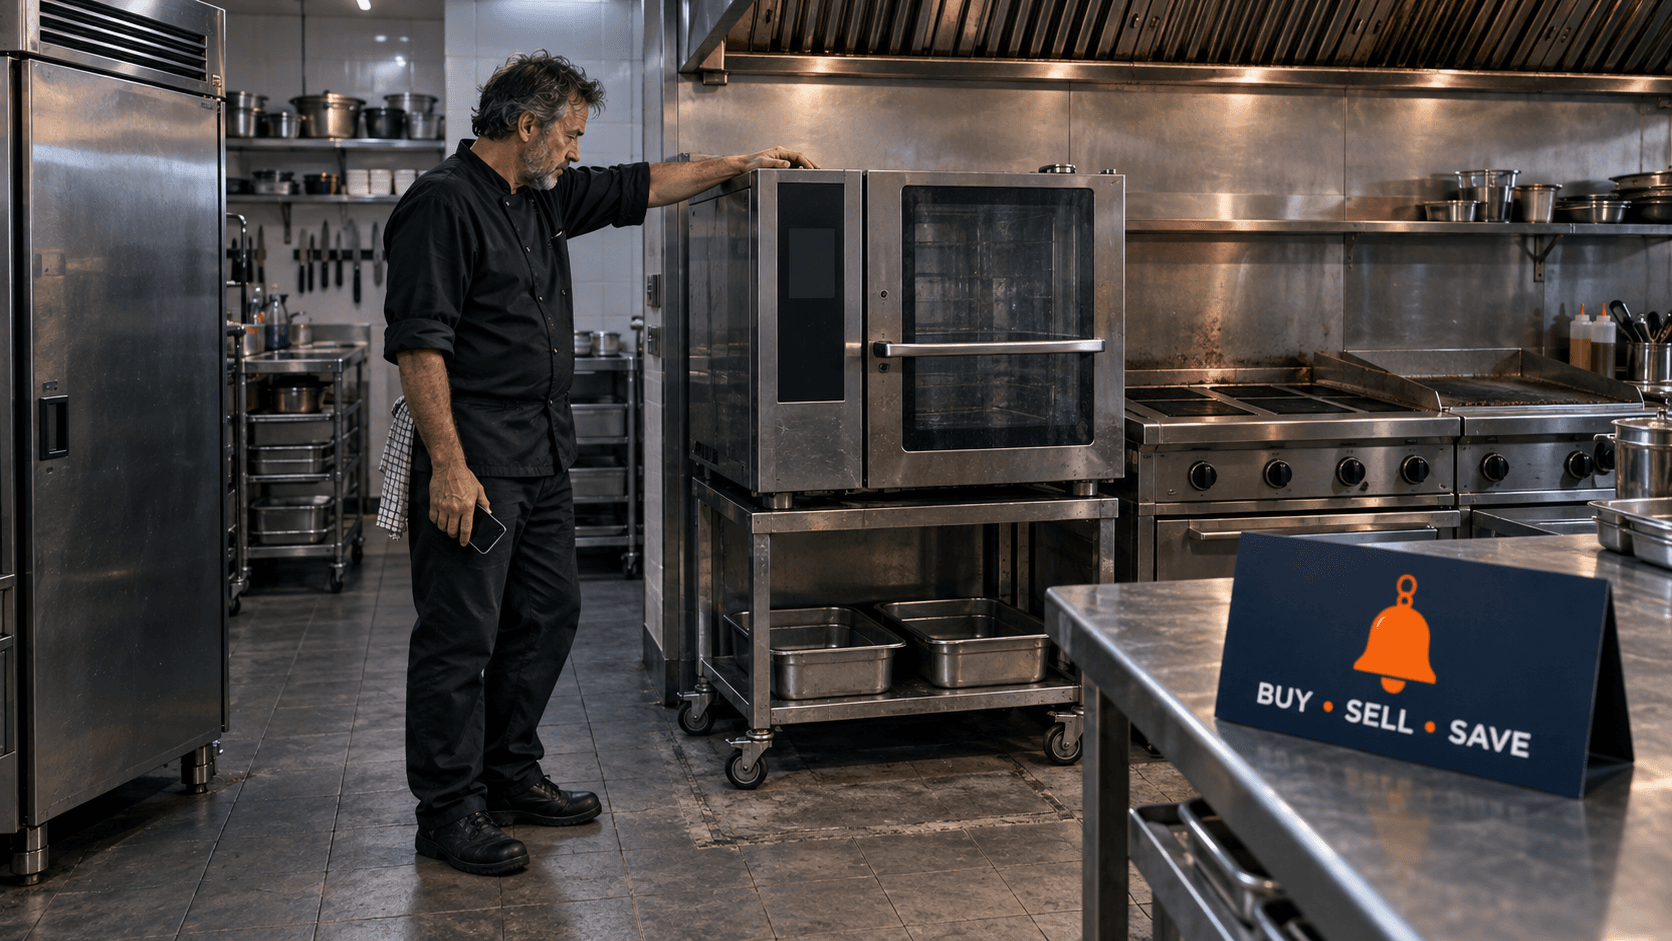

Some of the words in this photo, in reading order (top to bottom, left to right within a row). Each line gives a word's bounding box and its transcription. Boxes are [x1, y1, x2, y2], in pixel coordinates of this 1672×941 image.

[1256, 681, 1313, 713] BUY
[1344, 699, 1414, 735] SELL
[1448, 719, 1532, 759] SAVE
